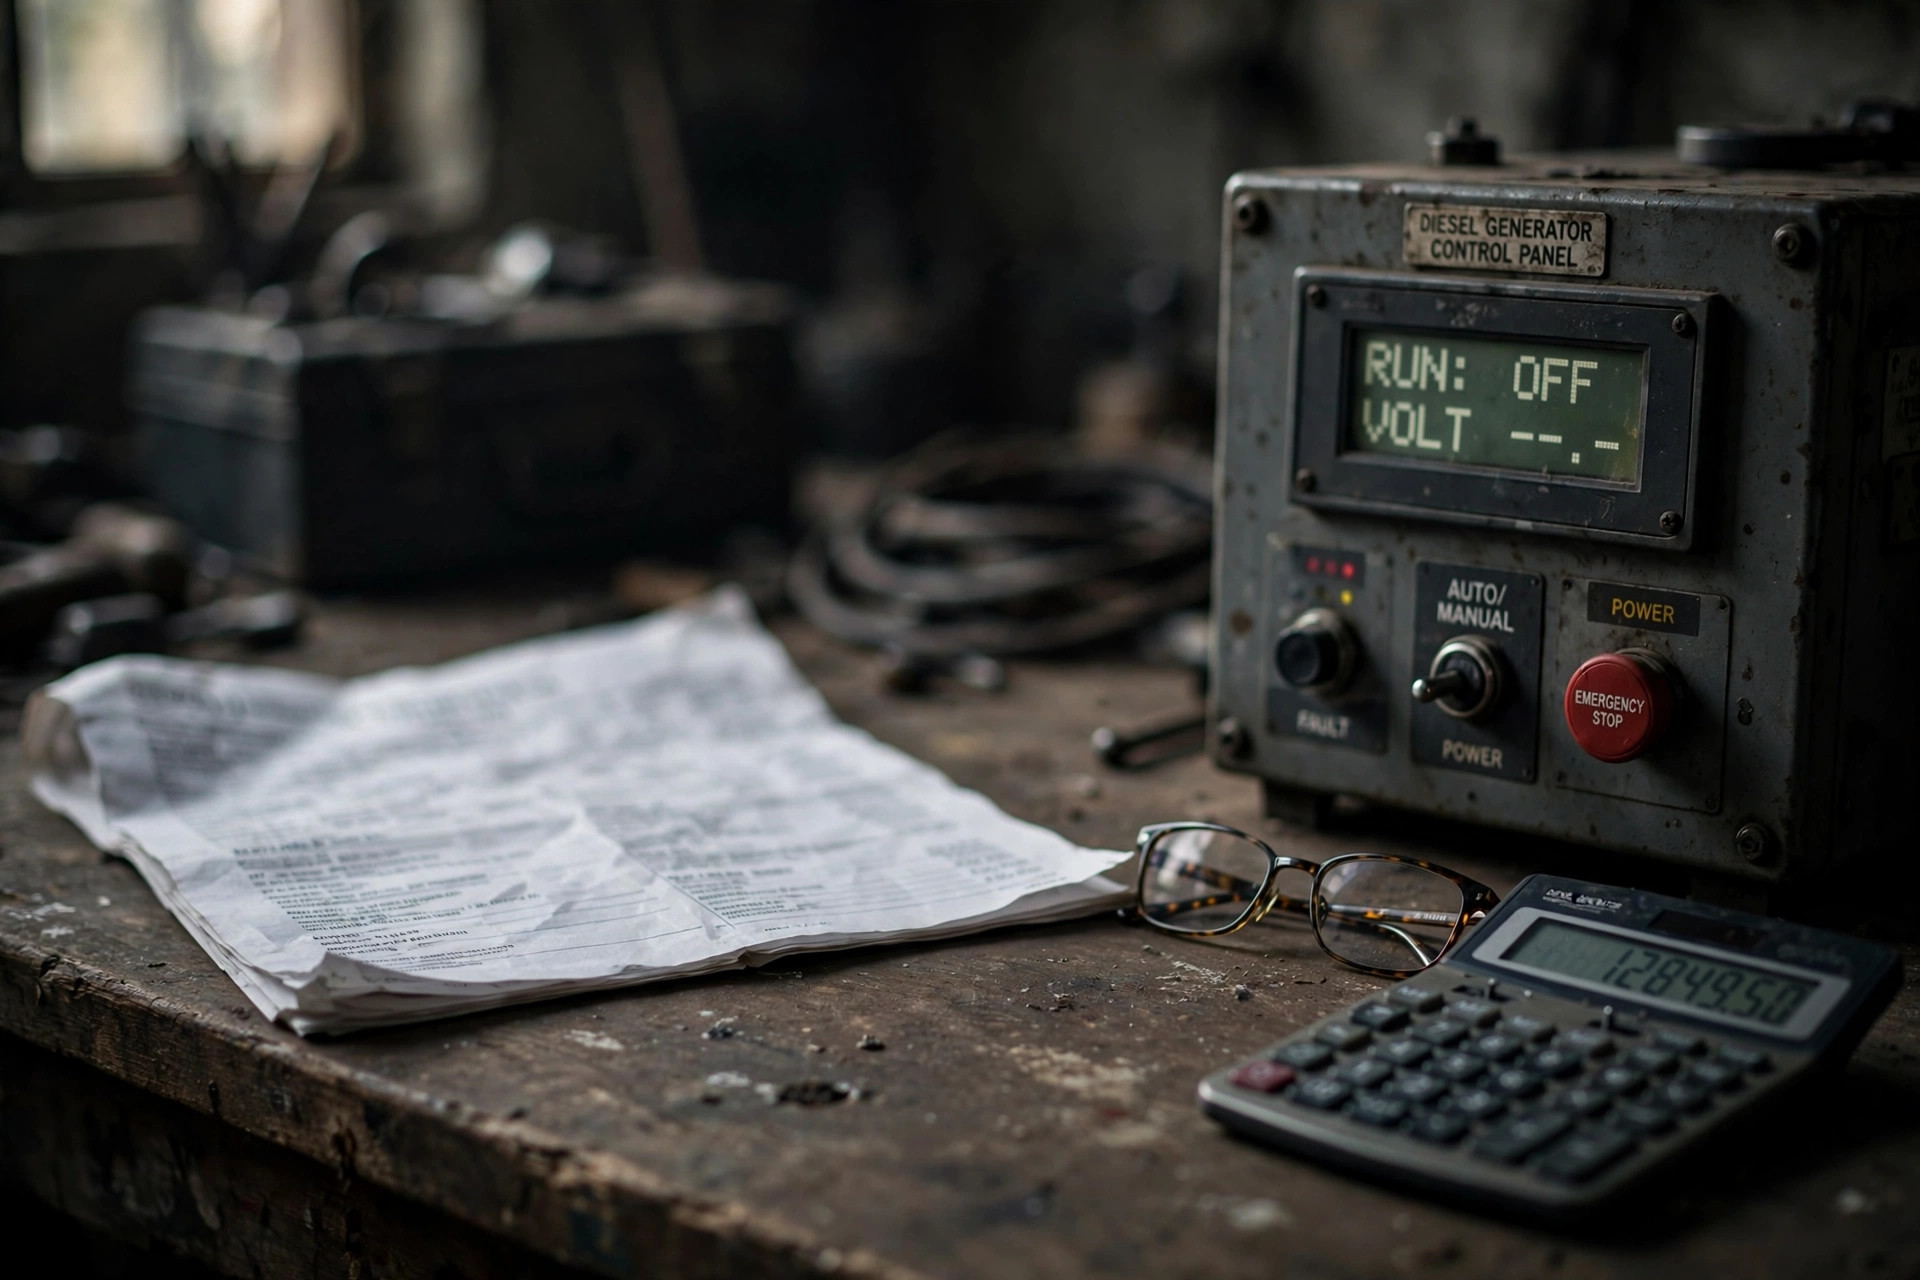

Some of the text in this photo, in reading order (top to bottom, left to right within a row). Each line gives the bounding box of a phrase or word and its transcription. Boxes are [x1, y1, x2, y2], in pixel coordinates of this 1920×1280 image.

[1420, 213, 1592, 242] DIESEL GENERATOR
[1431, 239, 1578, 268] CONTROL PANEL
[1365, 341, 1598, 404] RUN: OFF
[1362, 398, 1472, 452] VOLT
[1447, 578, 1507, 606] AUTO/
[1437, 602, 1515, 633] MANUAL
[1611, 598, 1675, 624] POWER
[1575, 689, 1646, 715] EMERGENCY
[1592, 711, 1624, 729] STOP
[1442, 739, 1503, 768] POWER
